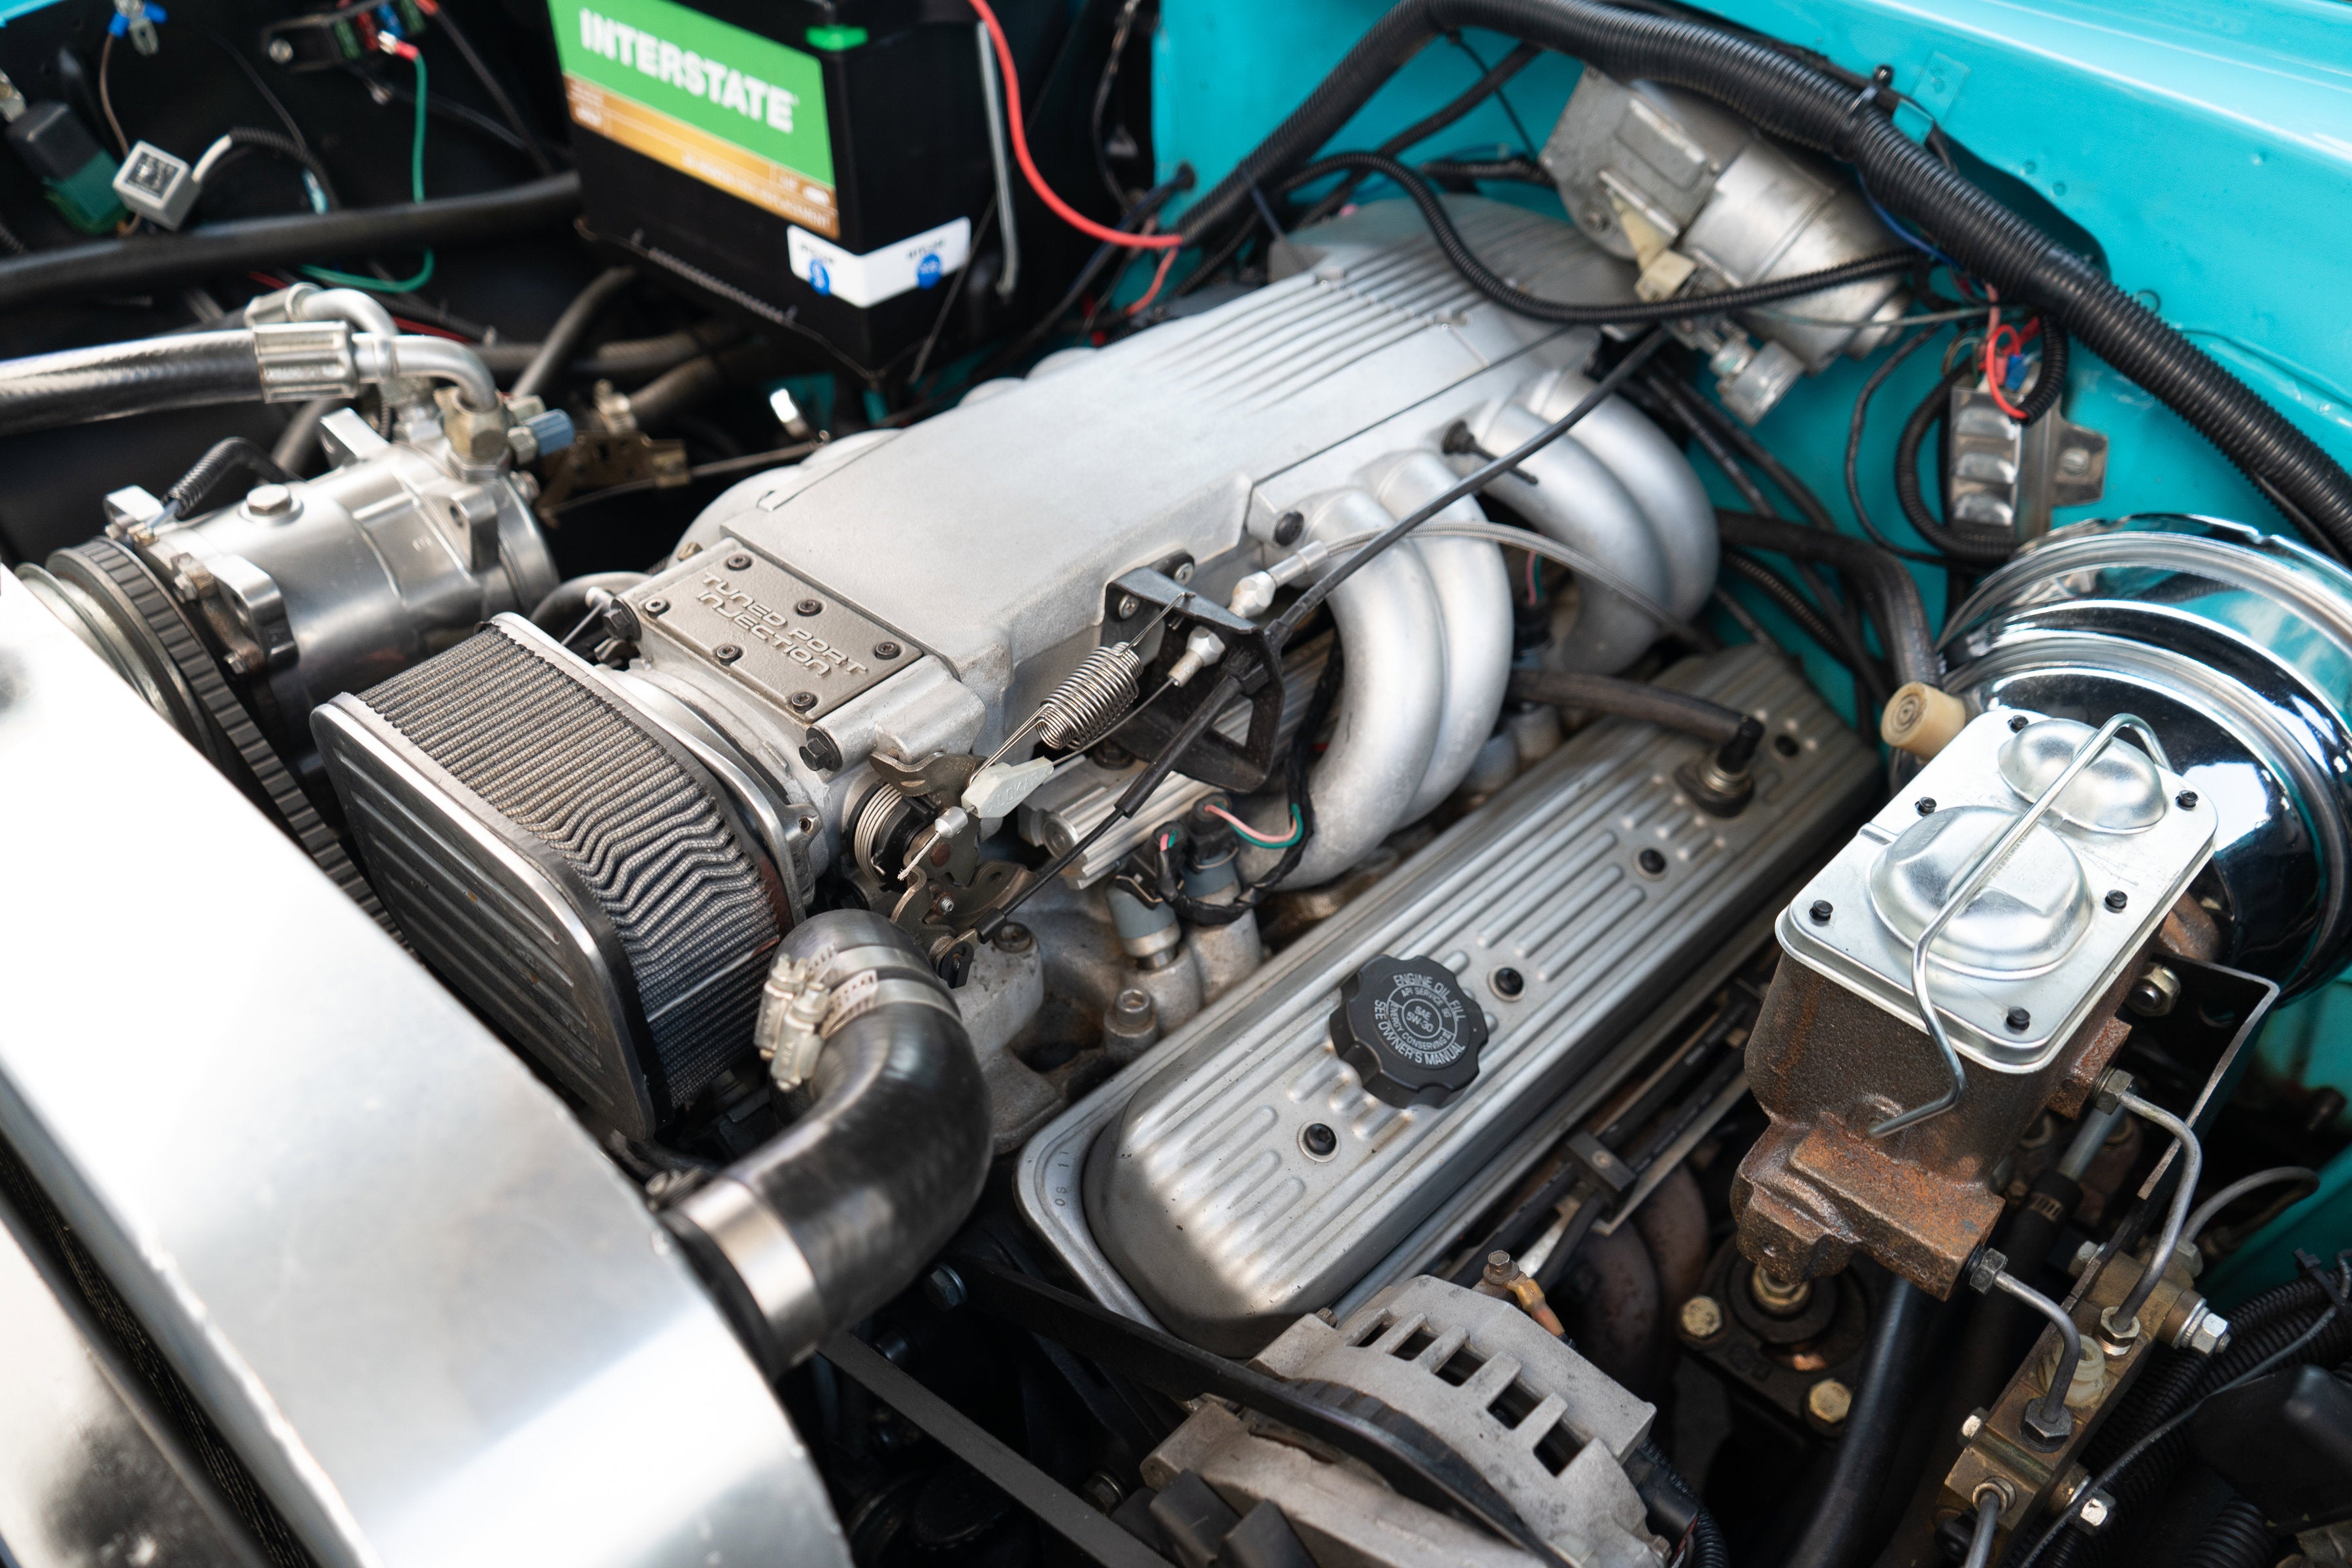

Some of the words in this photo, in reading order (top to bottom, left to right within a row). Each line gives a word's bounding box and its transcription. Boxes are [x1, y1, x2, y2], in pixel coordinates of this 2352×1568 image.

[579, 7, 794, 134] INTERSTATE
[696, 590, 832, 678] INJECTION
[702, 571, 789, 628] TUNED
[788, 626, 870, 676] PORT
[1374, 999, 1387, 1021] SEE
[1393, 972, 1433, 989] ENGINE
[1433, 982, 1452, 1001] OIL
[1450, 999, 1467, 1022] FILL
[1401, 987, 1414, 998] API
[1414, 987, 1445, 1007] SERVICE
[1414, 1005, 1433, 1022] SAE
[1378, 1021, 1424, 1064] OWNER'S
[1389, 1001, 1404, 1033] ENERGY
[1401, 1031, 1448, 1051] CONSERVING
[1405, 1011, 1435, 1033] 5W-30
[1424, 1041, 1466, 1066] MANUAL
